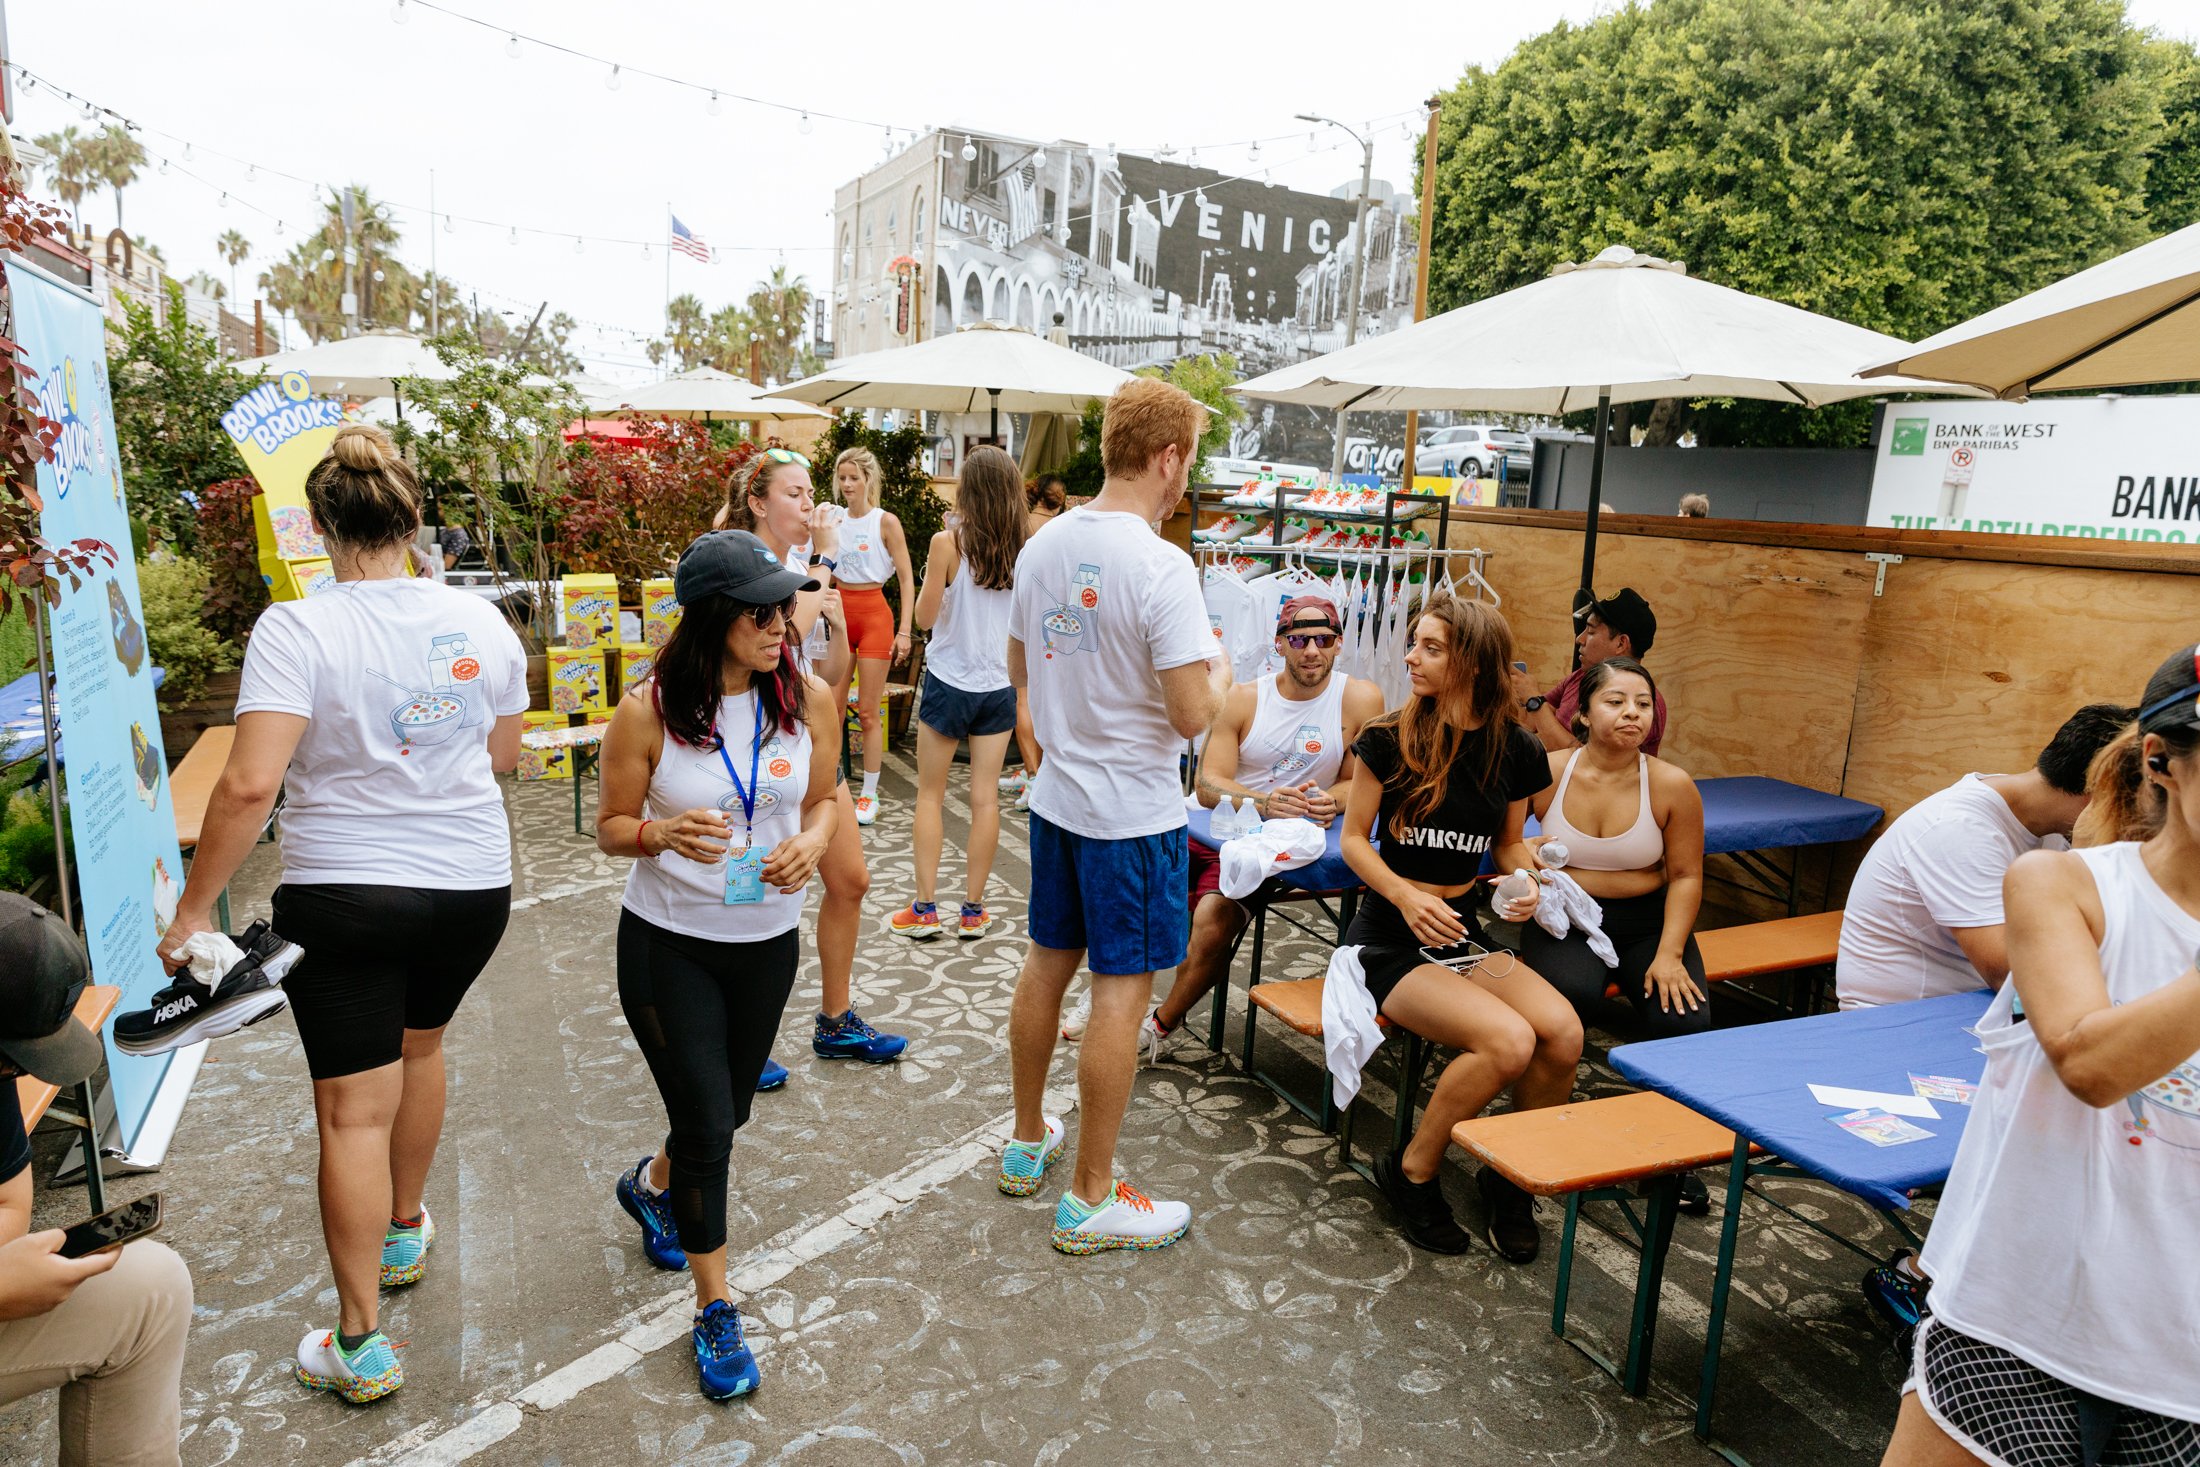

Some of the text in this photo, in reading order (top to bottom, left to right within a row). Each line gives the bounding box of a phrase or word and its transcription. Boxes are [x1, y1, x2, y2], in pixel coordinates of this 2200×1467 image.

[941, 195, 1009, 248] NEVER
[1159, 189, 1357, 254] VENIC
[221, 382, 290, 442] BOWL
[251, 401, 343, 454] BROOKS
[1935, 424, 1984, 438] BANK
[2004, 424, 2058, 438] WEST
[1332, 436, 1405, 472] Touc
[1933, 440, 2020, 451] BNP PARIBAS
[153, 994, 199, 1025] HOKA
